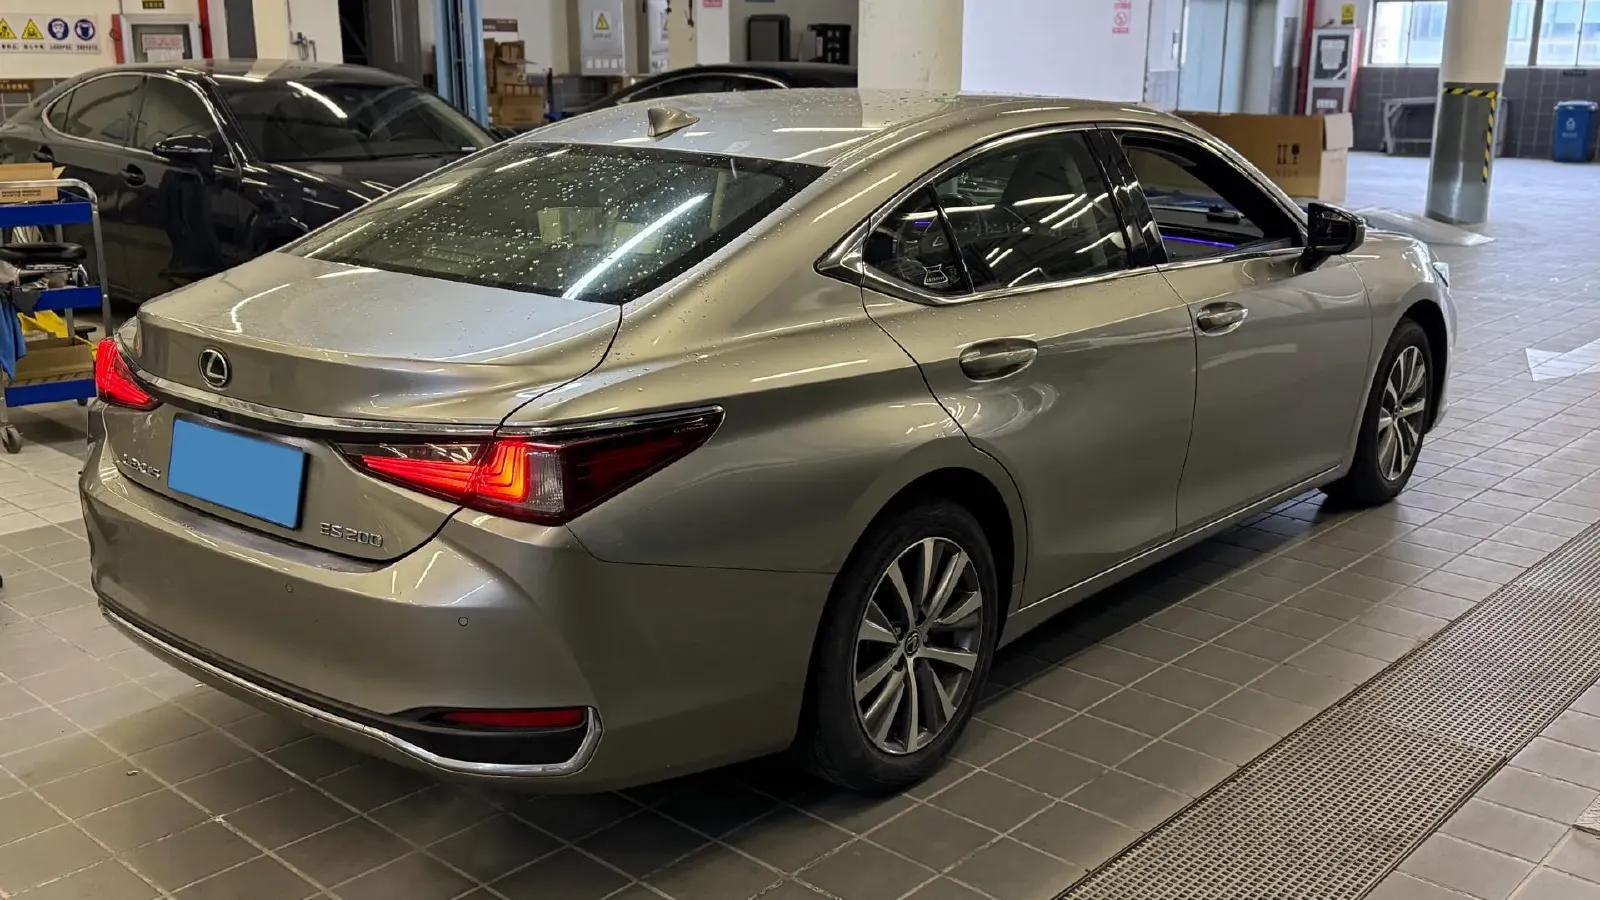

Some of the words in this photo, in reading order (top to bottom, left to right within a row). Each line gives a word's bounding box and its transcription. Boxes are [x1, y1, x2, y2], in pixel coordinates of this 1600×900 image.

[122, 452, 161, 479] LEXUS
[319, 521, 343, 538] ES
[345, 527, 383, 547] 200
